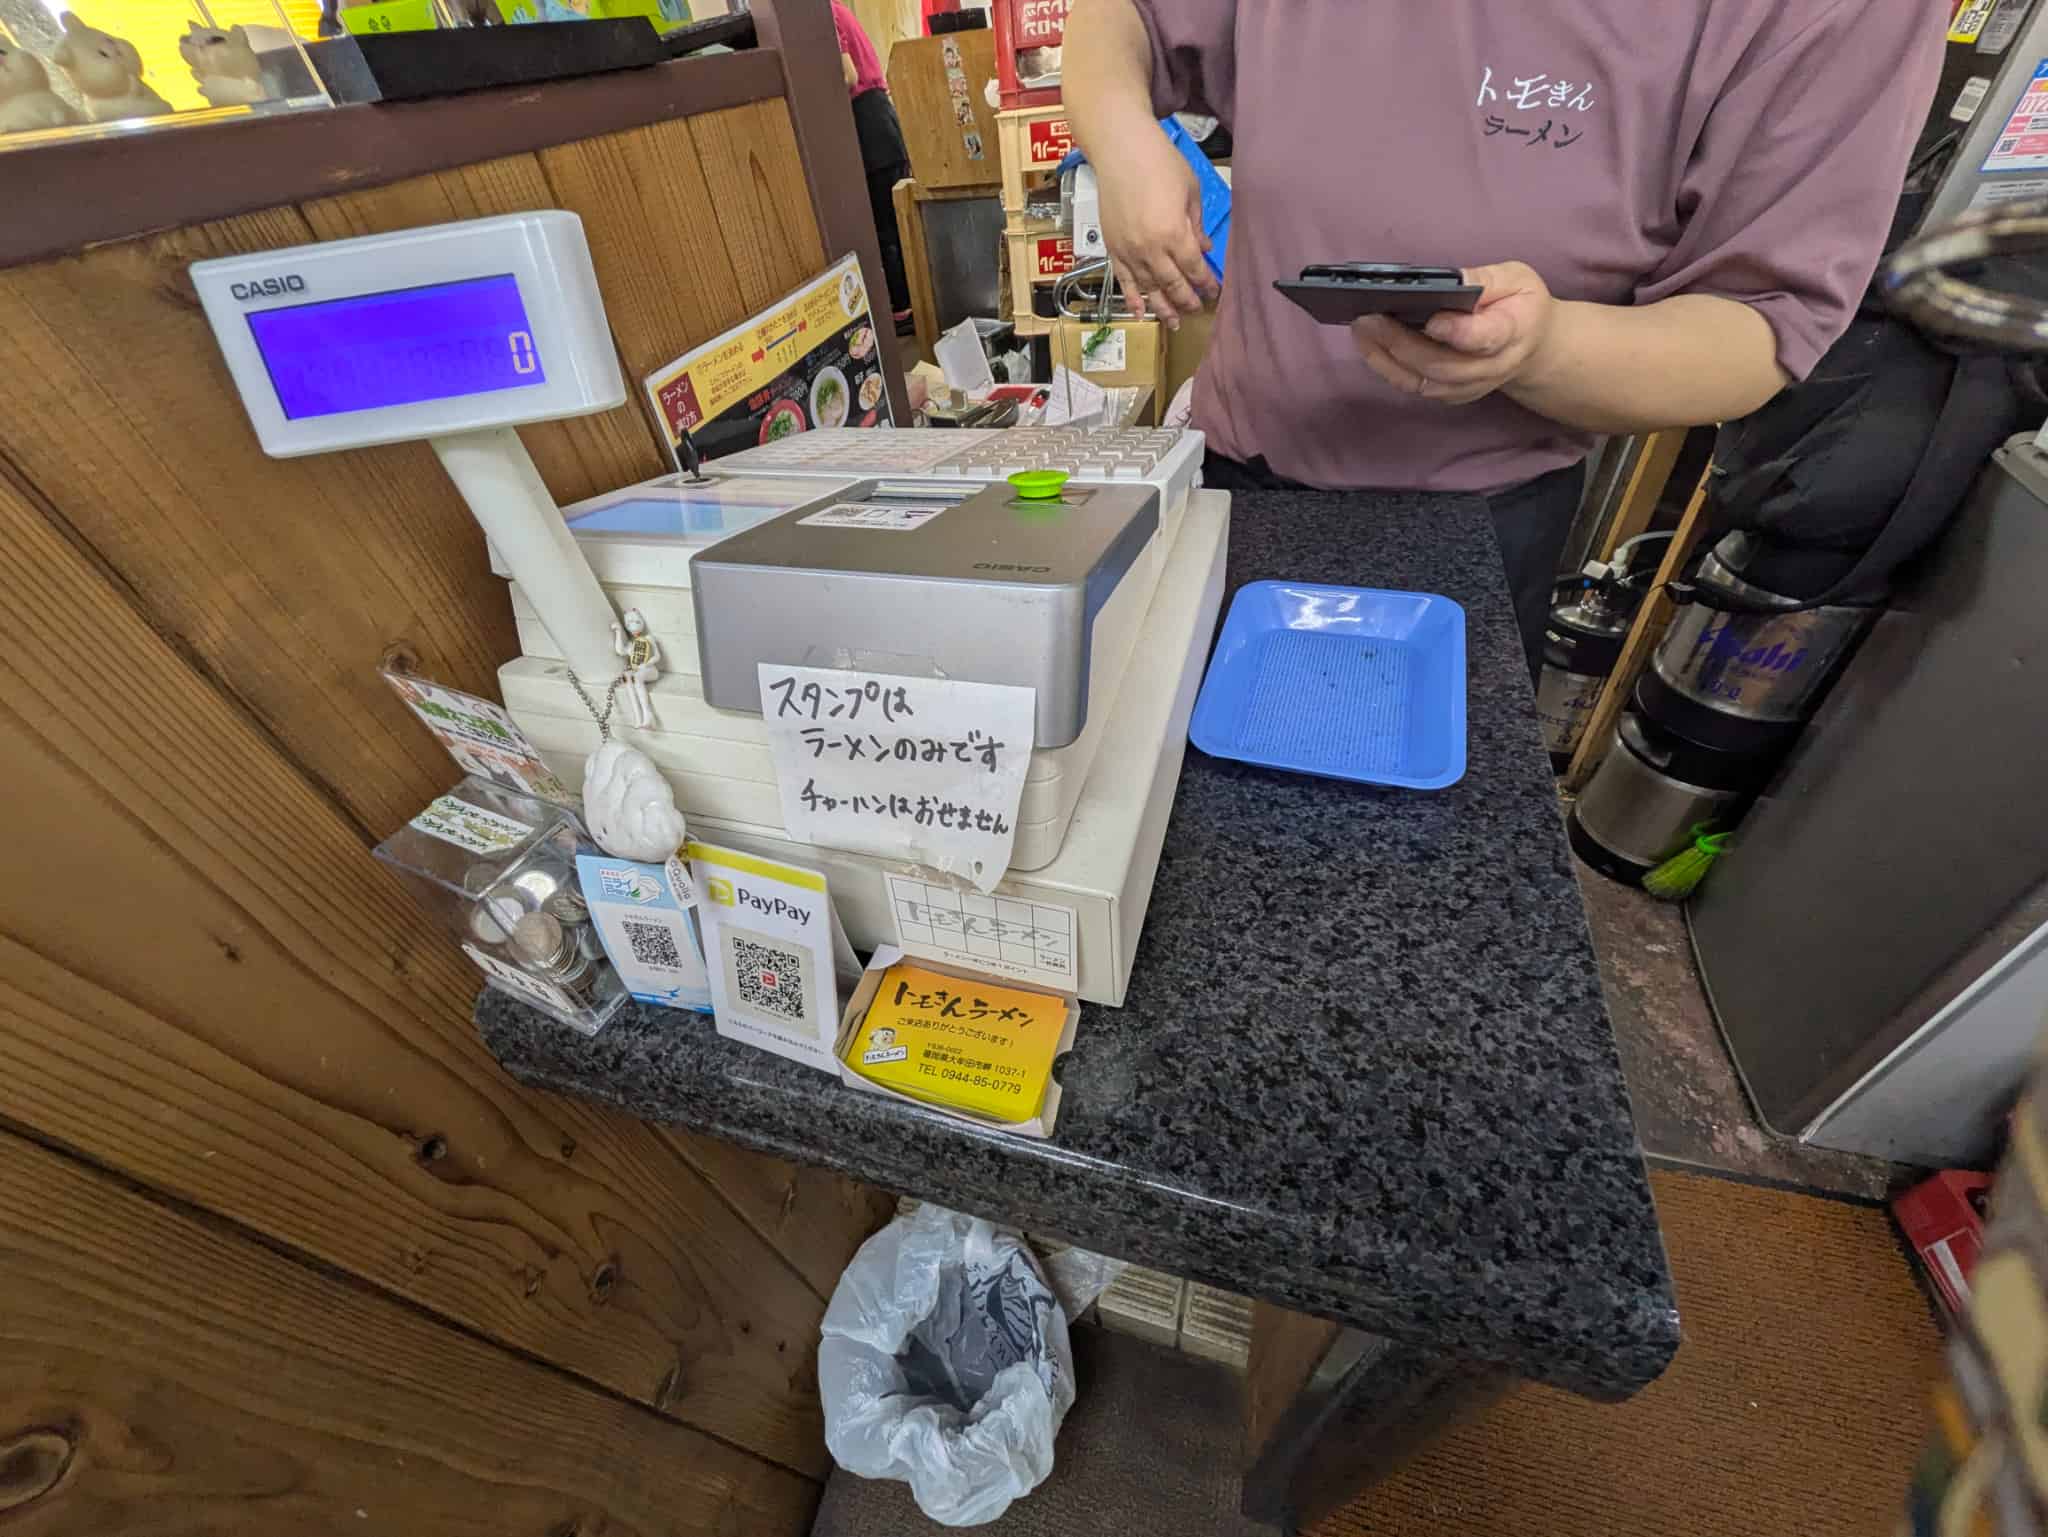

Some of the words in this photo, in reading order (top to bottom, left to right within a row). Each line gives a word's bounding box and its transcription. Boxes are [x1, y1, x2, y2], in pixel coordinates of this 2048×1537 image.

[1476, 66, 1595, 112] トモきん
[1482, 115, 1584, 149] ラーメン
[230, 273, 305, 301] CASIO
[508, 330, 536, 376] 0
[661, 380, 690, 407] ラーメン
[972, 563, 1052, 574] CASIO
[769, 676, 914, 723] スタンプは
[800, 728, 1005, 774] ラーメンのみです
[800, 778, 1009, 835] チャーハンはおせません
[737, 888, 811, 926] PayPay
[918, 1063, 938, 1077] TEL
